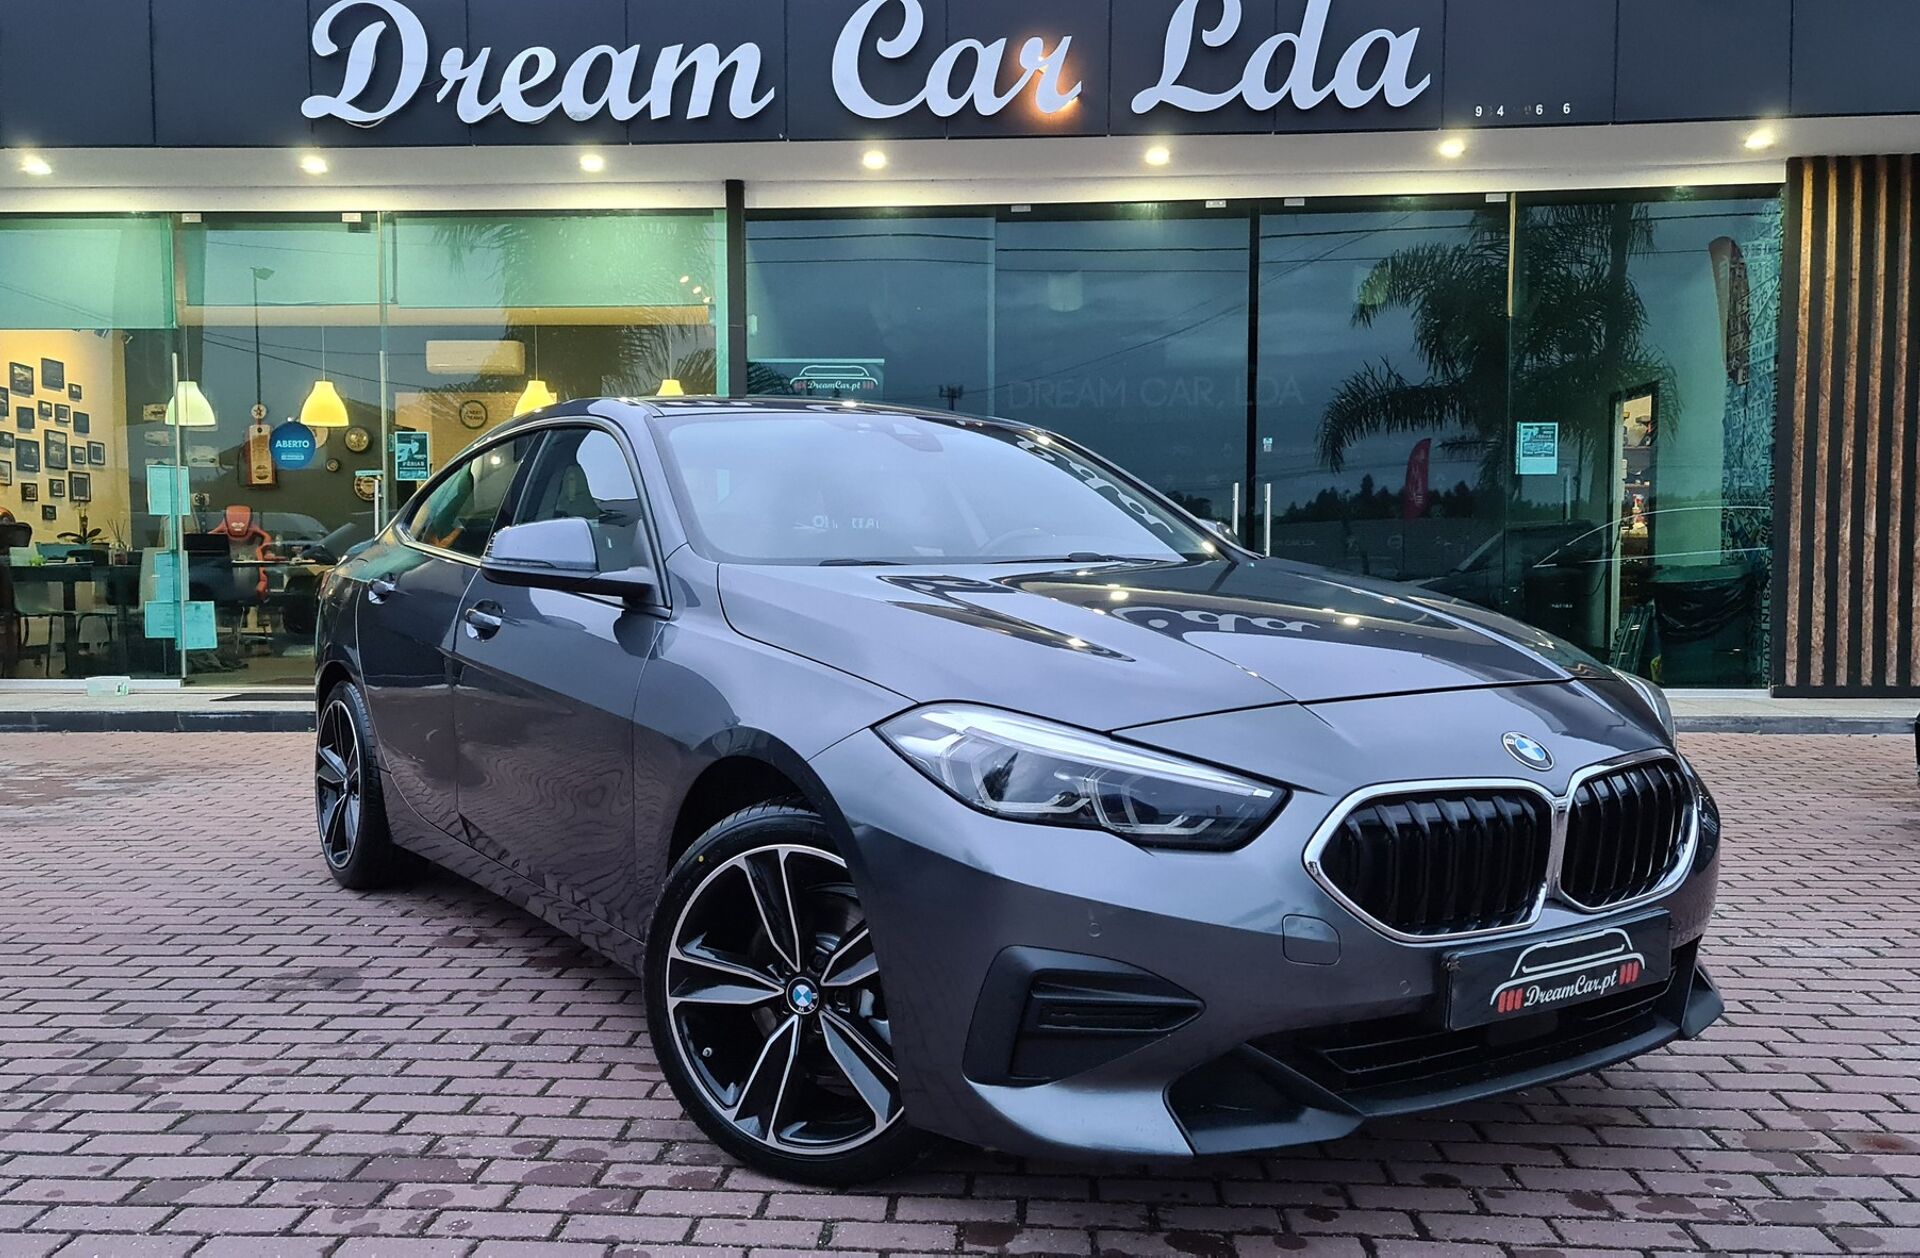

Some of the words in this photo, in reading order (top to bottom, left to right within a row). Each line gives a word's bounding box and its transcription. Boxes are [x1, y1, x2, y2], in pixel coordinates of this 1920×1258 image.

[301, 0, 775, 124] Dream
[832, 0, 1082, 119] Car
[1131, 0, 1431, 114] Lda
[807, 381, 861, 392] DreamCar.pt
[275, 439, 310, 449] ABERTO
[1523, 967, 1619, 1008] DreamCar.pt
